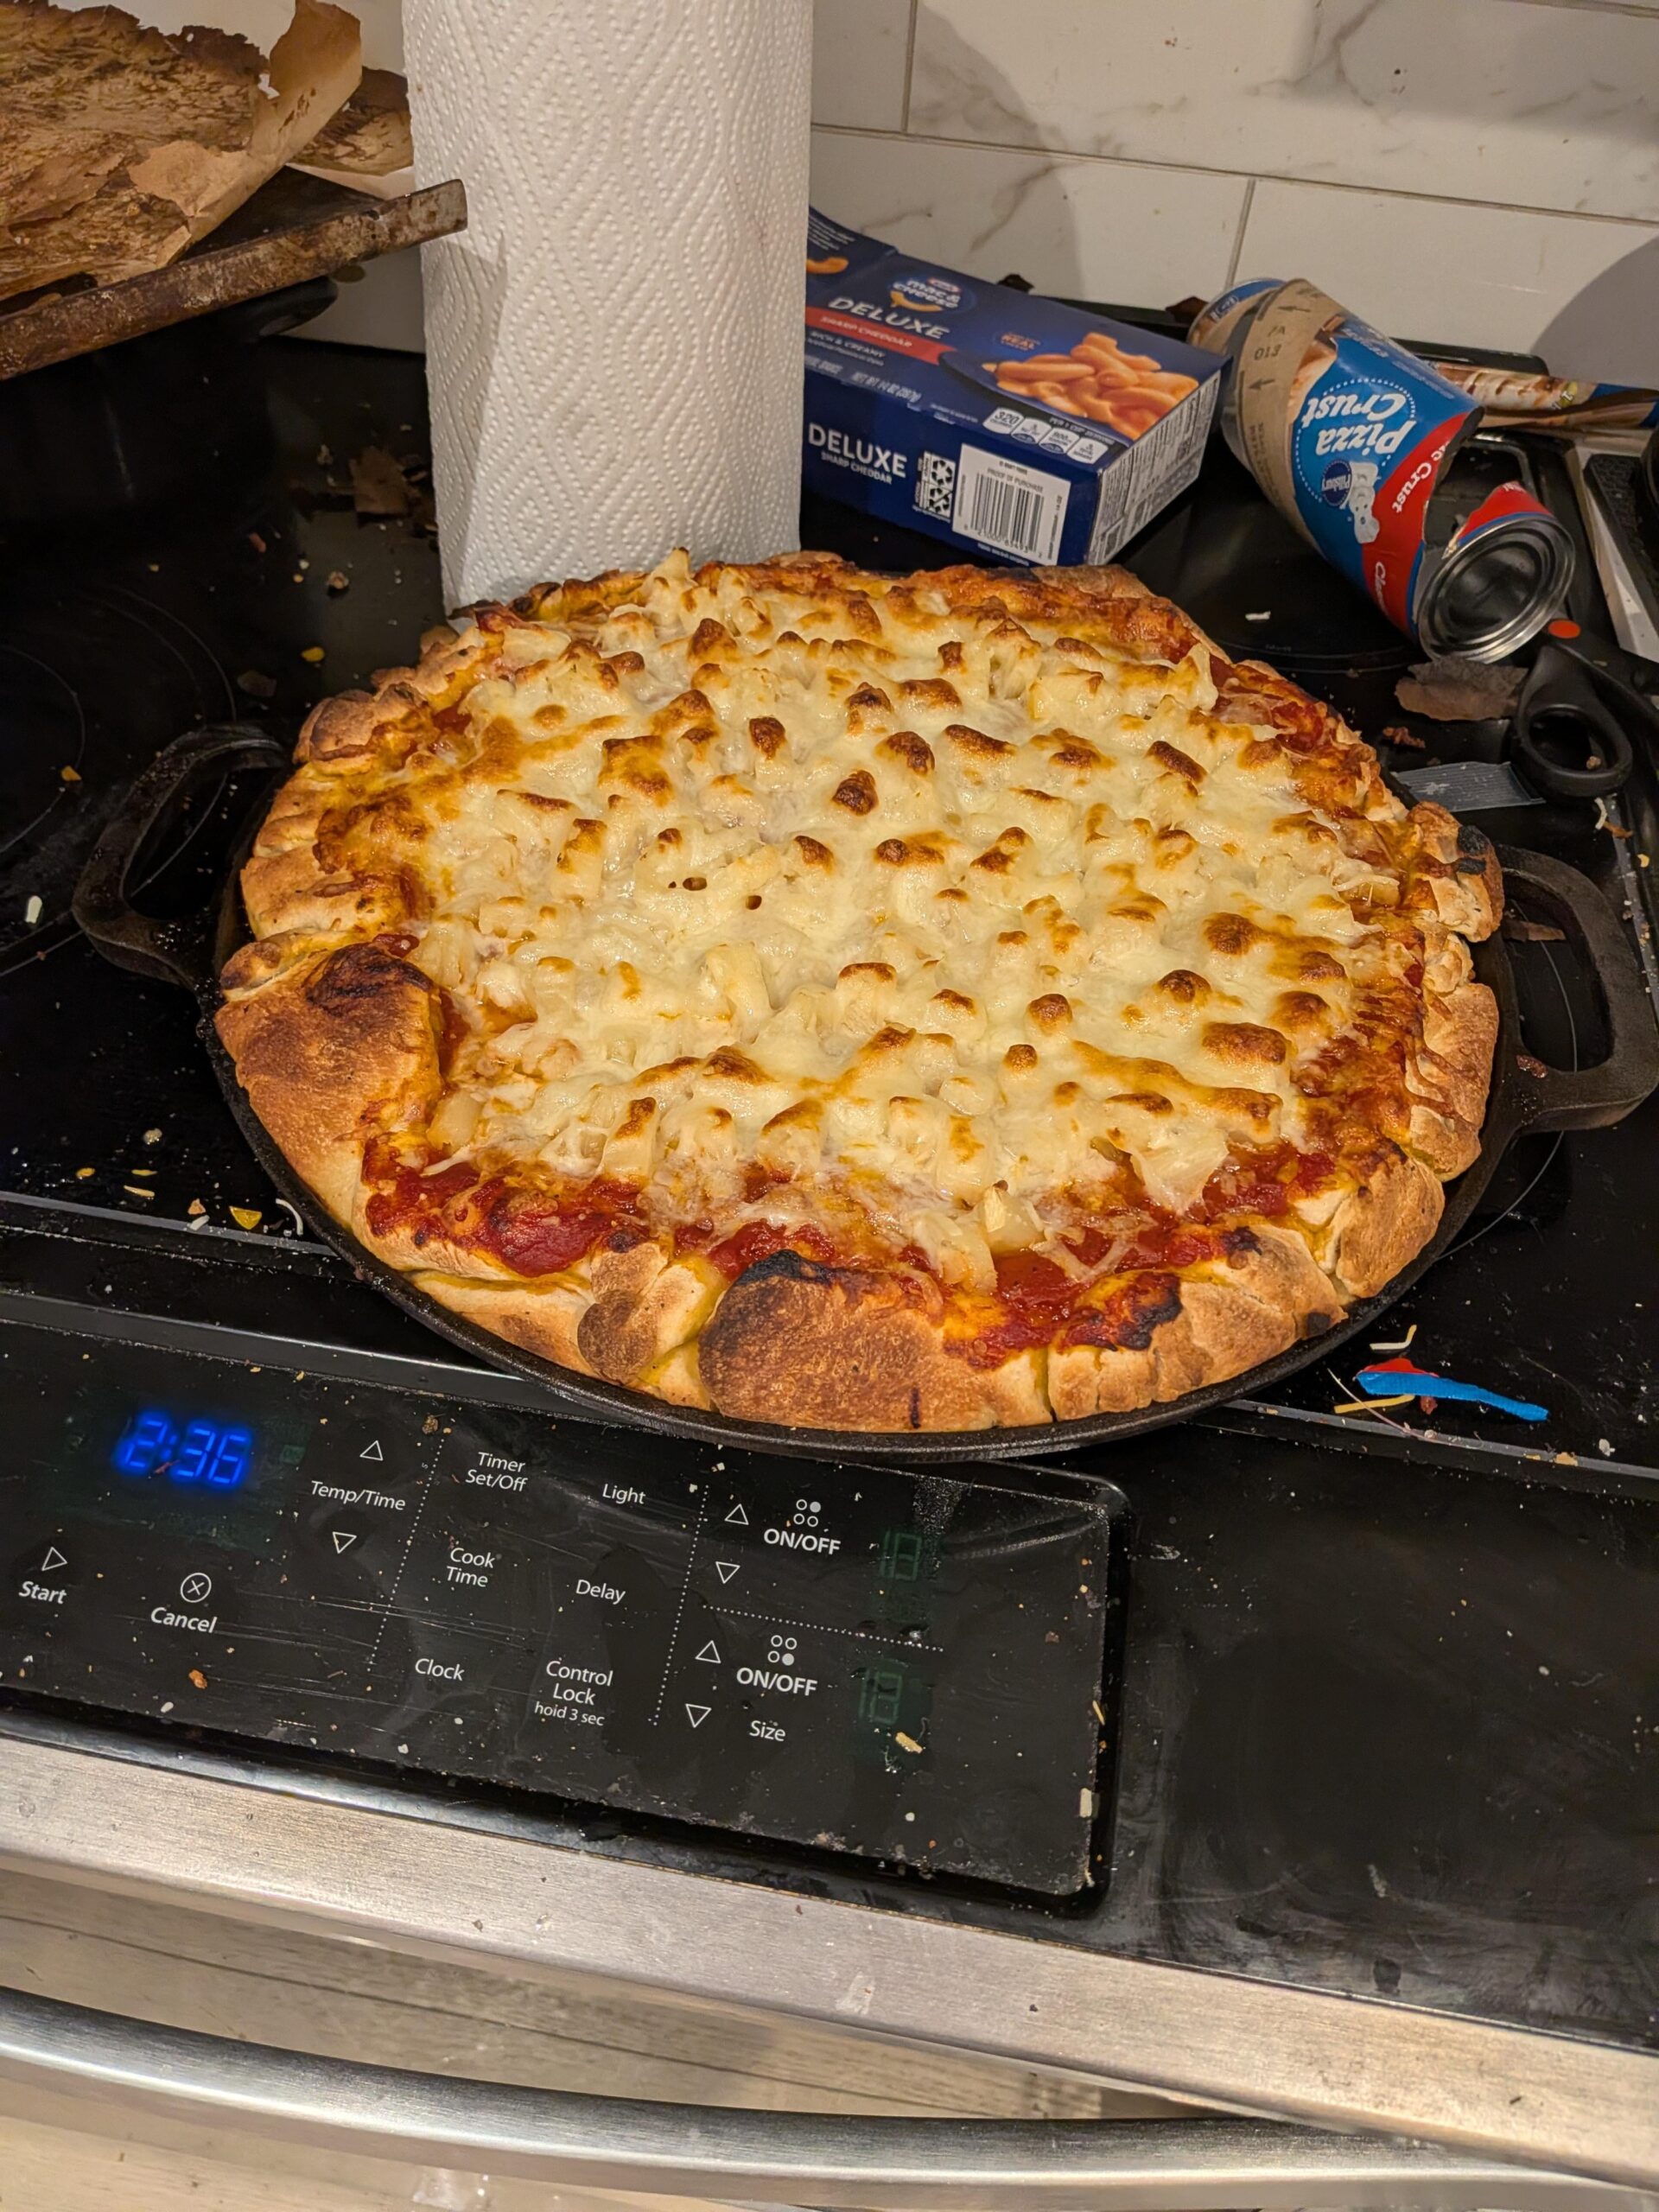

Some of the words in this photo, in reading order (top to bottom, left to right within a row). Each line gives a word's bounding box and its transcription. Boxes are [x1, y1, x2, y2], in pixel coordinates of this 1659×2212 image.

[828, 296, 950, 340] DELUXE
[858, 326, 913, 347] CHEDDAR
[994, 410, 1020, 426] 320
[1300, 392, 1407, 429] Crust
[808, 422, 908, 479] DELUXE
[1315, 420, 1417, 456] Pizza
[821, 451, 850, 467] SHARP
[850, 461, 893, 486] CHEDDAR
[1391, 461, 1433, 513] Crust
[123, 1419, 249, 1485] 2:36
[477, 1451, 526, 1474] Timer
[464, 1467, 529, 1492] Set/Off
[309, 1479, 407, 1511] Temp/Time
[601, 1483, 646, 1505] Light
[763, 1528, 842, 1556] ON/OFF
[448, 1546, 496, 1568] Cook
[446, 1566, 489, 1588] Time
[17, 1580, 68, 1605] Start
[575, 1578, 626, 1605] Delay
[149, 1605, 218, 1634] Cancel
[414, 1657, 466, 1682] Clock
[545, 1660, 614, 1687] Control
[735, 1666, 819, 1697] ON/OFF
[552, 1681, 596, 1706] Lock
[569, 1707, 579, 1721] 3
[581, 1712, 606, 1726] sec
[748, 1719, 787, 1743] Size
